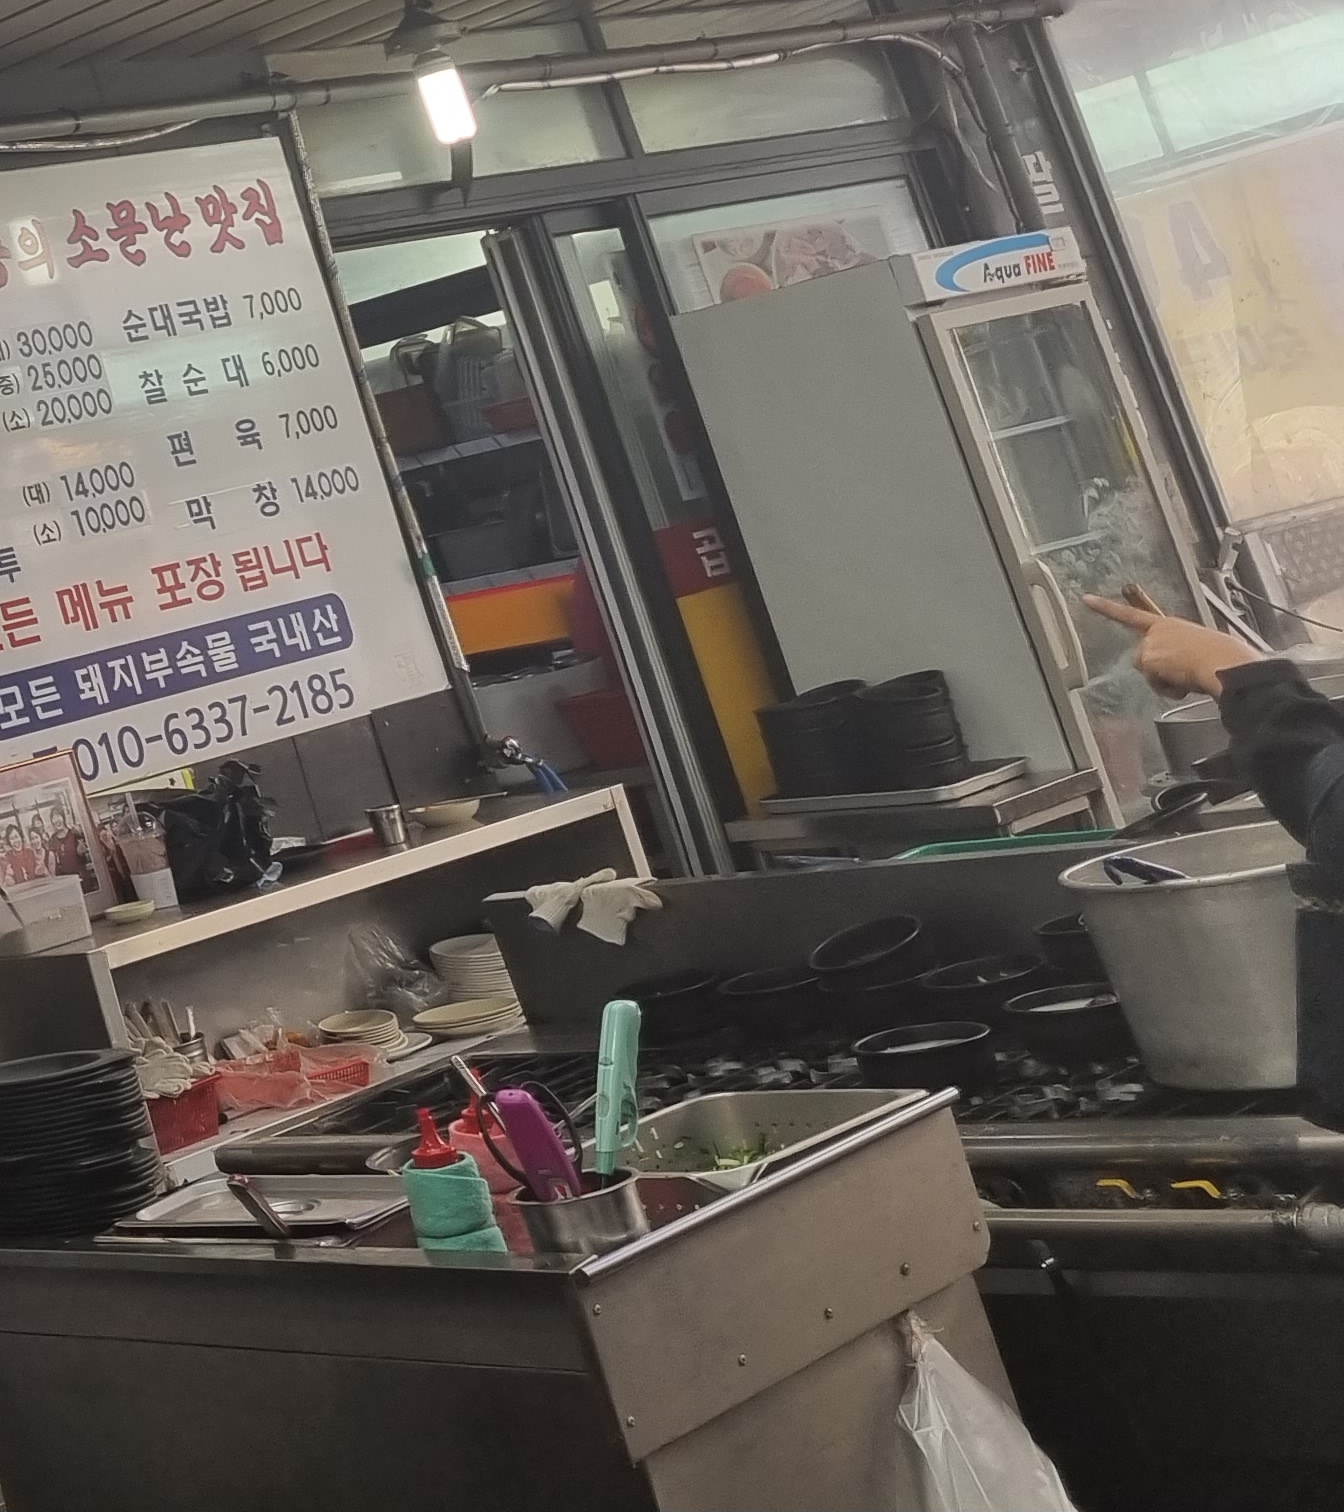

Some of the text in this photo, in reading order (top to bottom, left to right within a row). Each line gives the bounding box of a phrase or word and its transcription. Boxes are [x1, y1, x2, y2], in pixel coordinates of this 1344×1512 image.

[983, 251, 1056, 284] Aqua FINE
[16, 321, 94, 358] 30,000
[122, 294, 233, 344] 순대국밥
[243, 287, 303, 320] 7,000
[27, 354, 104, 392] 25,000
[262, 344, 320, 377] 6,000
[2, 407, 32, 433] (소)
[36, 387, 113, 427] 20,000
[279, 405, 339, 440] 7,000
[22, 481, 51, 508] (대)
[59, 461, 135, 503] 14,000
[33, 519, 62, 547] (소)
[70, 496, 146, 537] 10,000
[290, 466, 360, 504] 14,000
[55, 579, 135, 632] 메뉴
[150, 552, 226, 611] 포장
[231, 532, 333, 592] 됩니다
[73, 630, 240, 707] 돼지부속물
[247, 603, 343, 659] 국내산
[71, 667, 355, 782] 010-6337-2185
